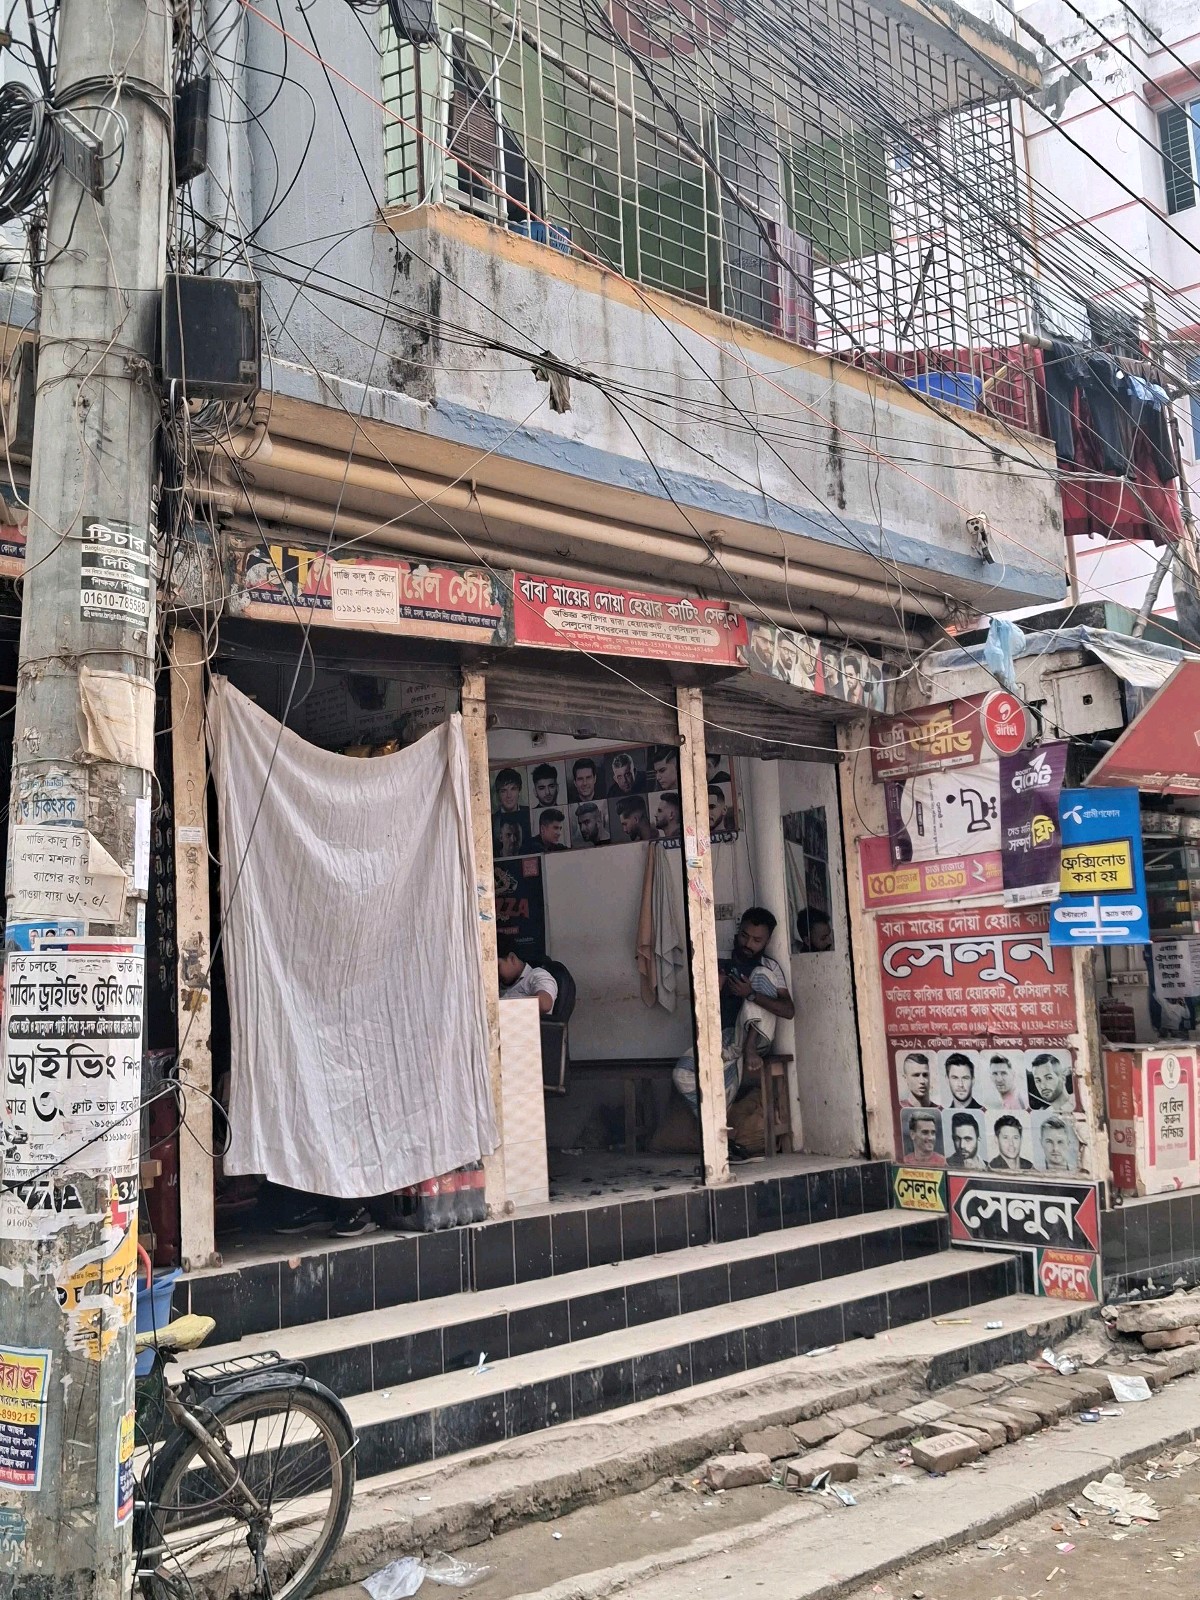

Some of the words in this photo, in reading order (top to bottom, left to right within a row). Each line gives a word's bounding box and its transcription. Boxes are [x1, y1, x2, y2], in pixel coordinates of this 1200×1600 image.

[85, 523, 147, 553] টিচার
[333, 569, 350, 580] গাজি
[352, 572, 368, 583] কালু
[368, 571, 376, 581] টি
[378, 573, 396, 583] স্টোর
[519, 578, 549, 604] বাবা
[550, 583, 591, 609] মায়ের
[594, 590, 626, 615] দোয়া
[628, 597, 664, 619] হেয়ার
[664, 598, 702, 625] কাটিং
[704, 607, 739, 630] সেলুন
[581, 612, 607, 623] কারিগর
[561, 620, 592, 631] সেলুনের
[632, 629, 648, 638] কাজ
[674, 635, 688, 643] করা
[996, 722, 1018, 736] airtel
[1083, 808, 1120, 819] গ্রামীণফোন
[26, 833, 45, 844] গাজি
[47, 835, 68, 849] কালু
[72, 835, 82, 847] টি
[20, 853, 45, 863] এখানে
[48, 855, 76, 866] মশলা
[1062, 853, 1126, 871] ফ্লেক্সিলোড
[33, 870, 64, 881] ব্যাগের
[68, 873, 80, 885] রং
[84, 875, 95, 887] চা
[1072, 870, 1097, 883] করা
[1100, 870, 1118, 882] হয়
[18, 889, 45, 900] পাওয়া
[45, 891, 63, 902] যায়
[881, 920, 905, 937] বাবা
[908, 917, 945, 935] মায়ের
[948, 914, 980, 933] দোয়া
[984, 912, 1022, 930] হেয়ার
[29, 961, 58, 974] চলছে
[117, 957, 135, 973] ভর্তি
[882, 932, 1055, 985] সেলুন
[39, 974, 88, 1012] ড্রাইভিং
[92, 974, 123, 1012] ট্রেনিং
[913, 984, 943, 1001] কারিগর
[1013, 980, 1051, 998] ফেসিয়াল
[1053, 982, 1070, 998] সহ
[895, 1004, 927, 1022] সেলুনের
[928, 1003, 968, 1019] সবধরনের
[970, 1003, 989, 1017] কাজ
[1019, 1001, 1038, 1016] করা
[7, 1043, 117, 1088] ড্রাইভিং
[897, 1178, 939, 1203] সেলুন
[960, 1189, 1080, 1242] সেলুন
[1041, 1261, 1090, 1293] সেলুন
